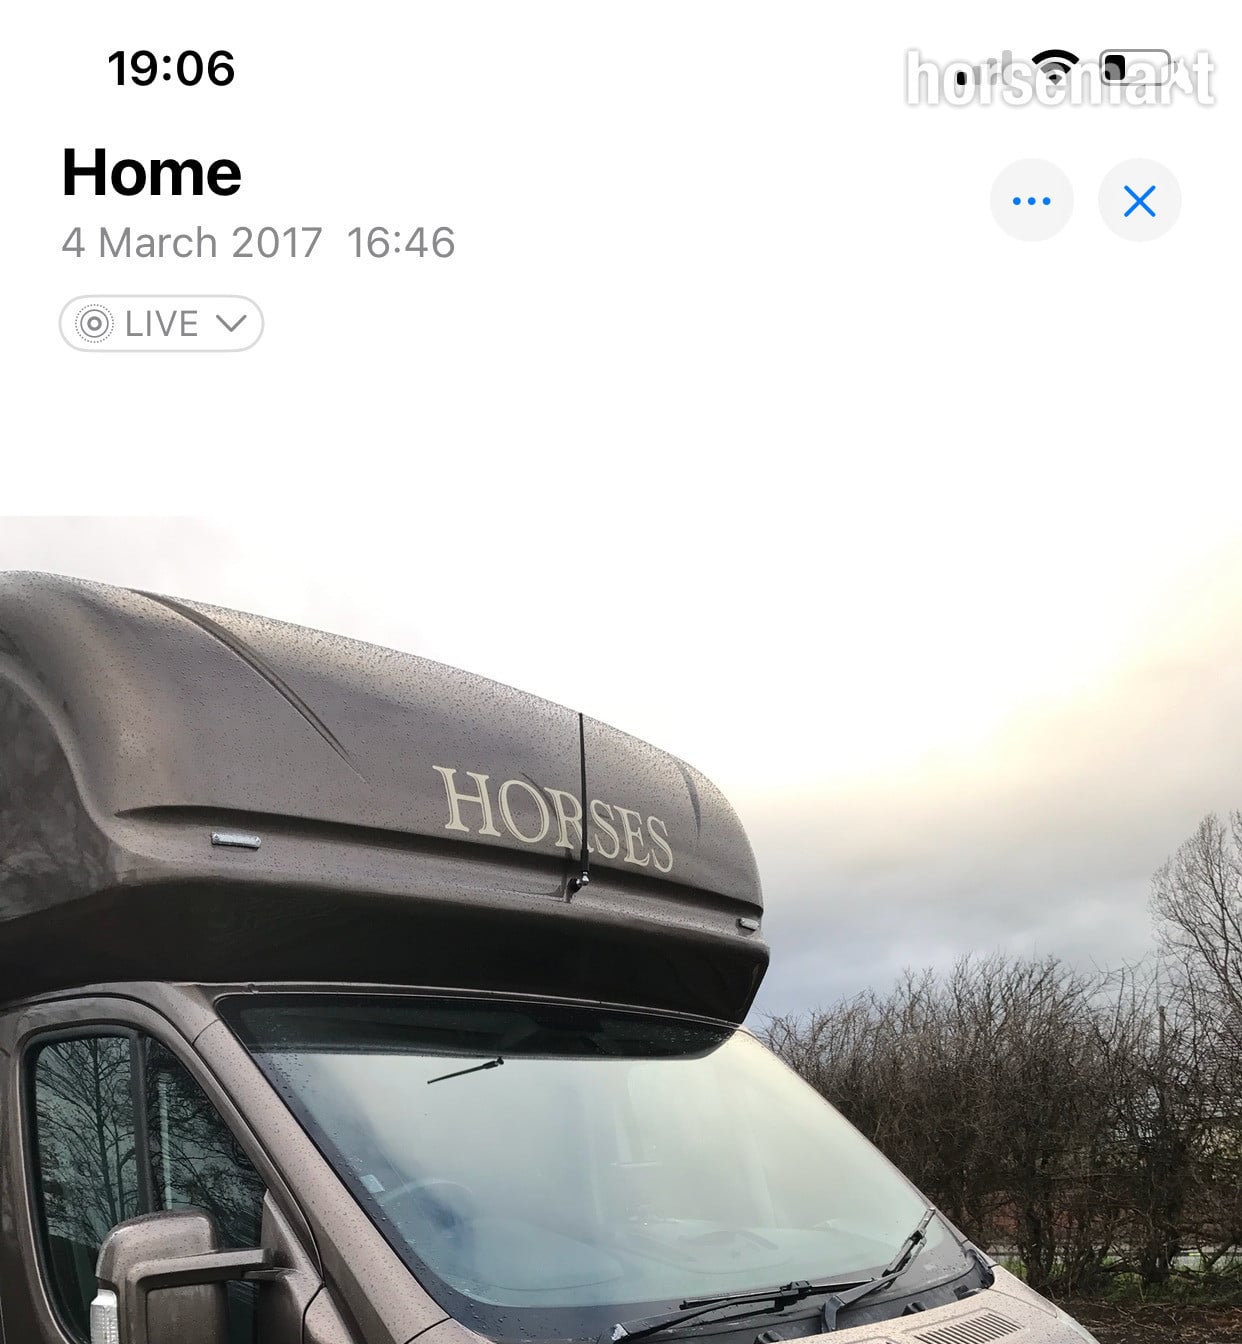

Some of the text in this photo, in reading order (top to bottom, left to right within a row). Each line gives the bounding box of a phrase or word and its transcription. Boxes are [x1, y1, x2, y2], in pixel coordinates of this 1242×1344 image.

[109, 50, 234, 86] 19:06
[64, 148, 241, 196] Home
[62, 226, 454, 258] 4 March 2017 16:46
[127, 310, 197, 336] LIVE
[432, 764, 673, 873] HORSES
